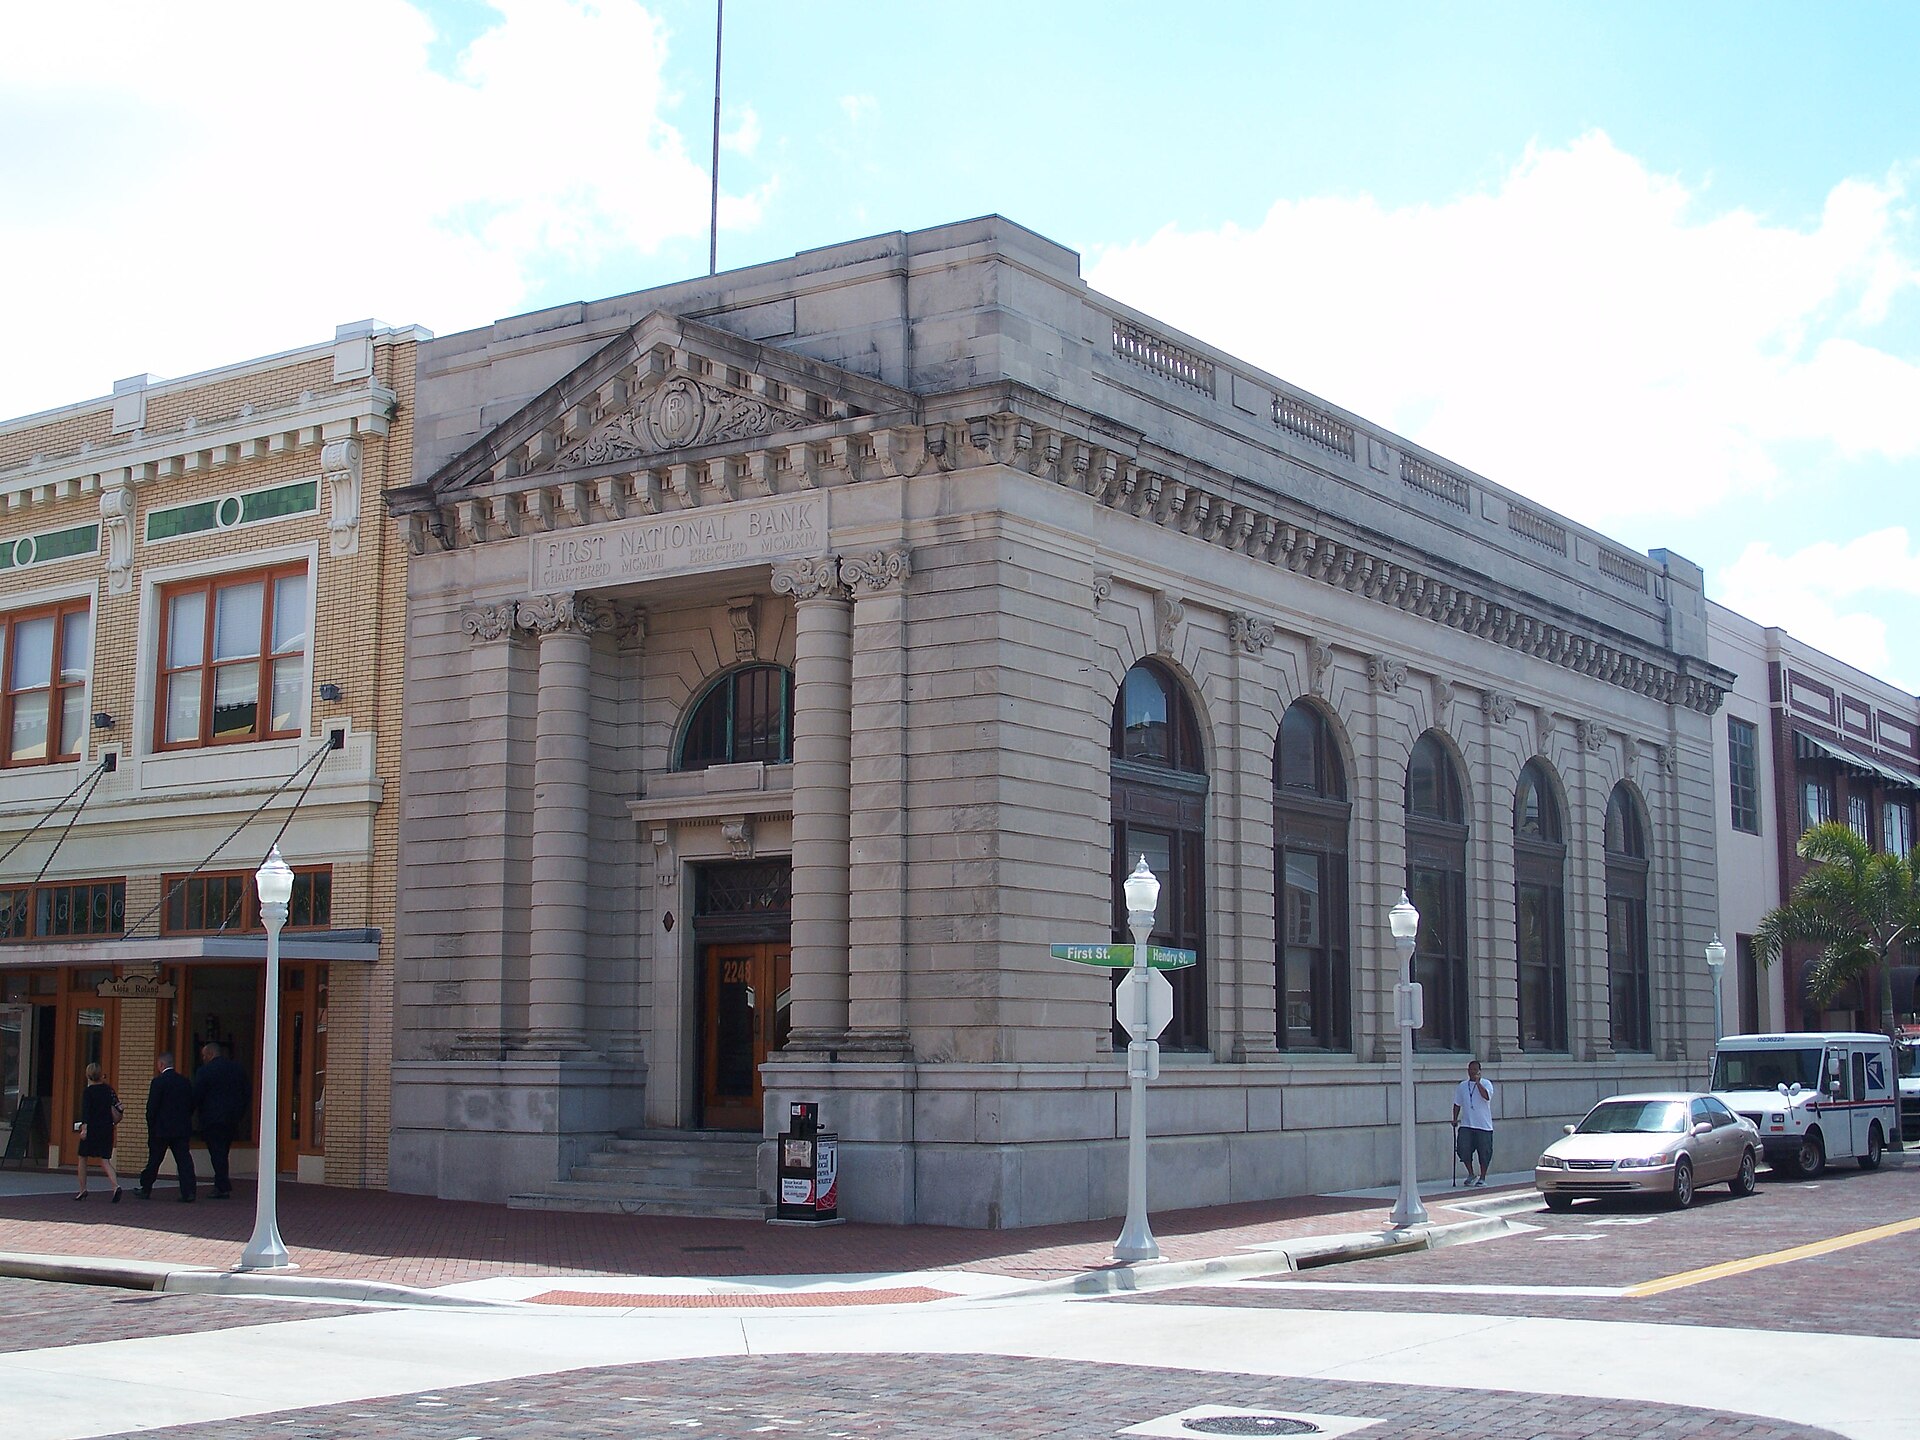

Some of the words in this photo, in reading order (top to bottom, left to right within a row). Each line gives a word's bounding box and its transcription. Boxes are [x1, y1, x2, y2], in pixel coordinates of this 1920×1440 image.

[546, 536, 607, 568] FIRST
[619, 515, 733, 557] NATIONAL
[747, 503, 813, 538] BANK
[543, 561, 611, 585] CHARTERED
[621, 553, 665, 574] MCMVII
[689, 541, 748, 564] ERECTED
[1067, 947, 1093, 960] First
[1095, 947, 1111, 960] St.
[1153, 948, 1178, 966] Hendry
[1178, 953, 1188, 964] St.
[723, 960, 752, 983] 2248
[135, 984, 159, 994] Roland
